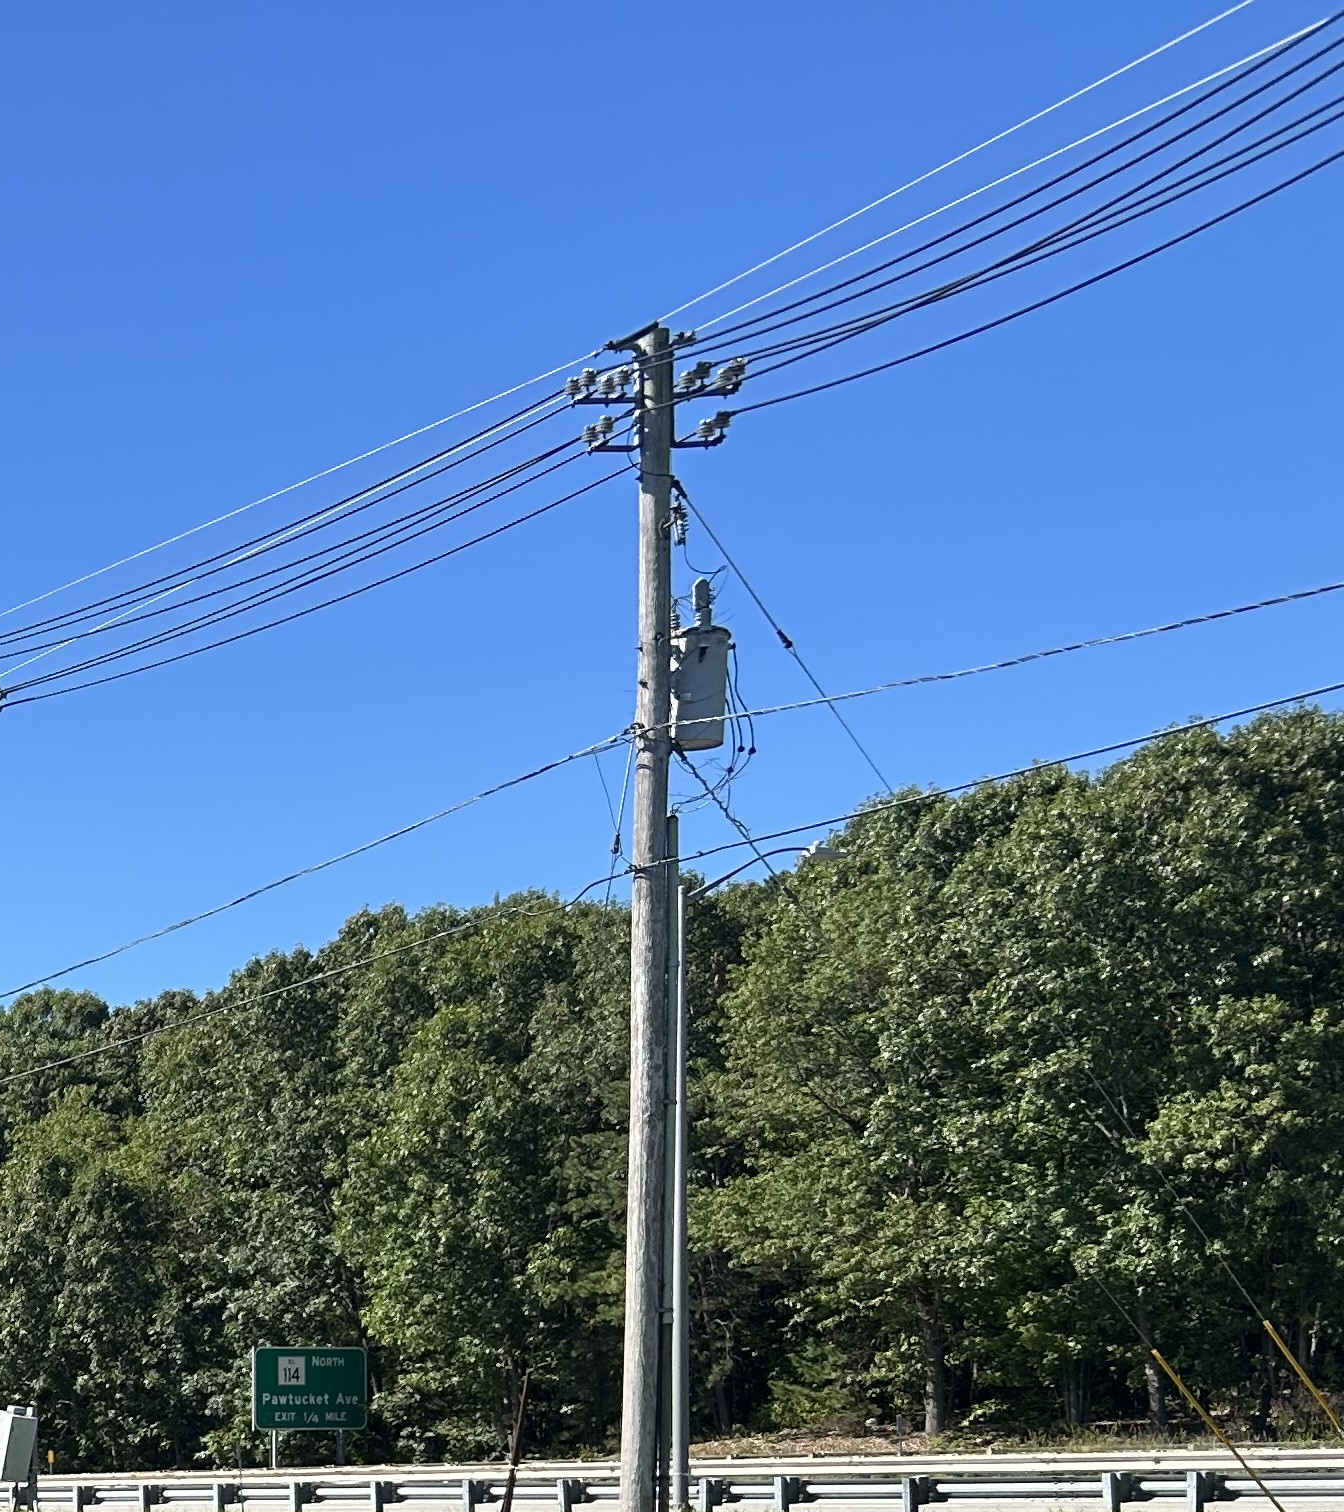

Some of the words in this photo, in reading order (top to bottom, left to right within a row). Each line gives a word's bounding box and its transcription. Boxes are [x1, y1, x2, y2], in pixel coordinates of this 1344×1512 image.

[311, 1355, 345, 1367] NORTH
[283, 1366, 300, 1383] 114
[262, 1392, 329, 1405] Pawtucket
[335, 1392, 359, 1405] Ave
[274, 1412, 296, 1421] EXIT
[303, 1412, 319, 1424] 1/4
[325, 1412, 347, 1421] MILE
